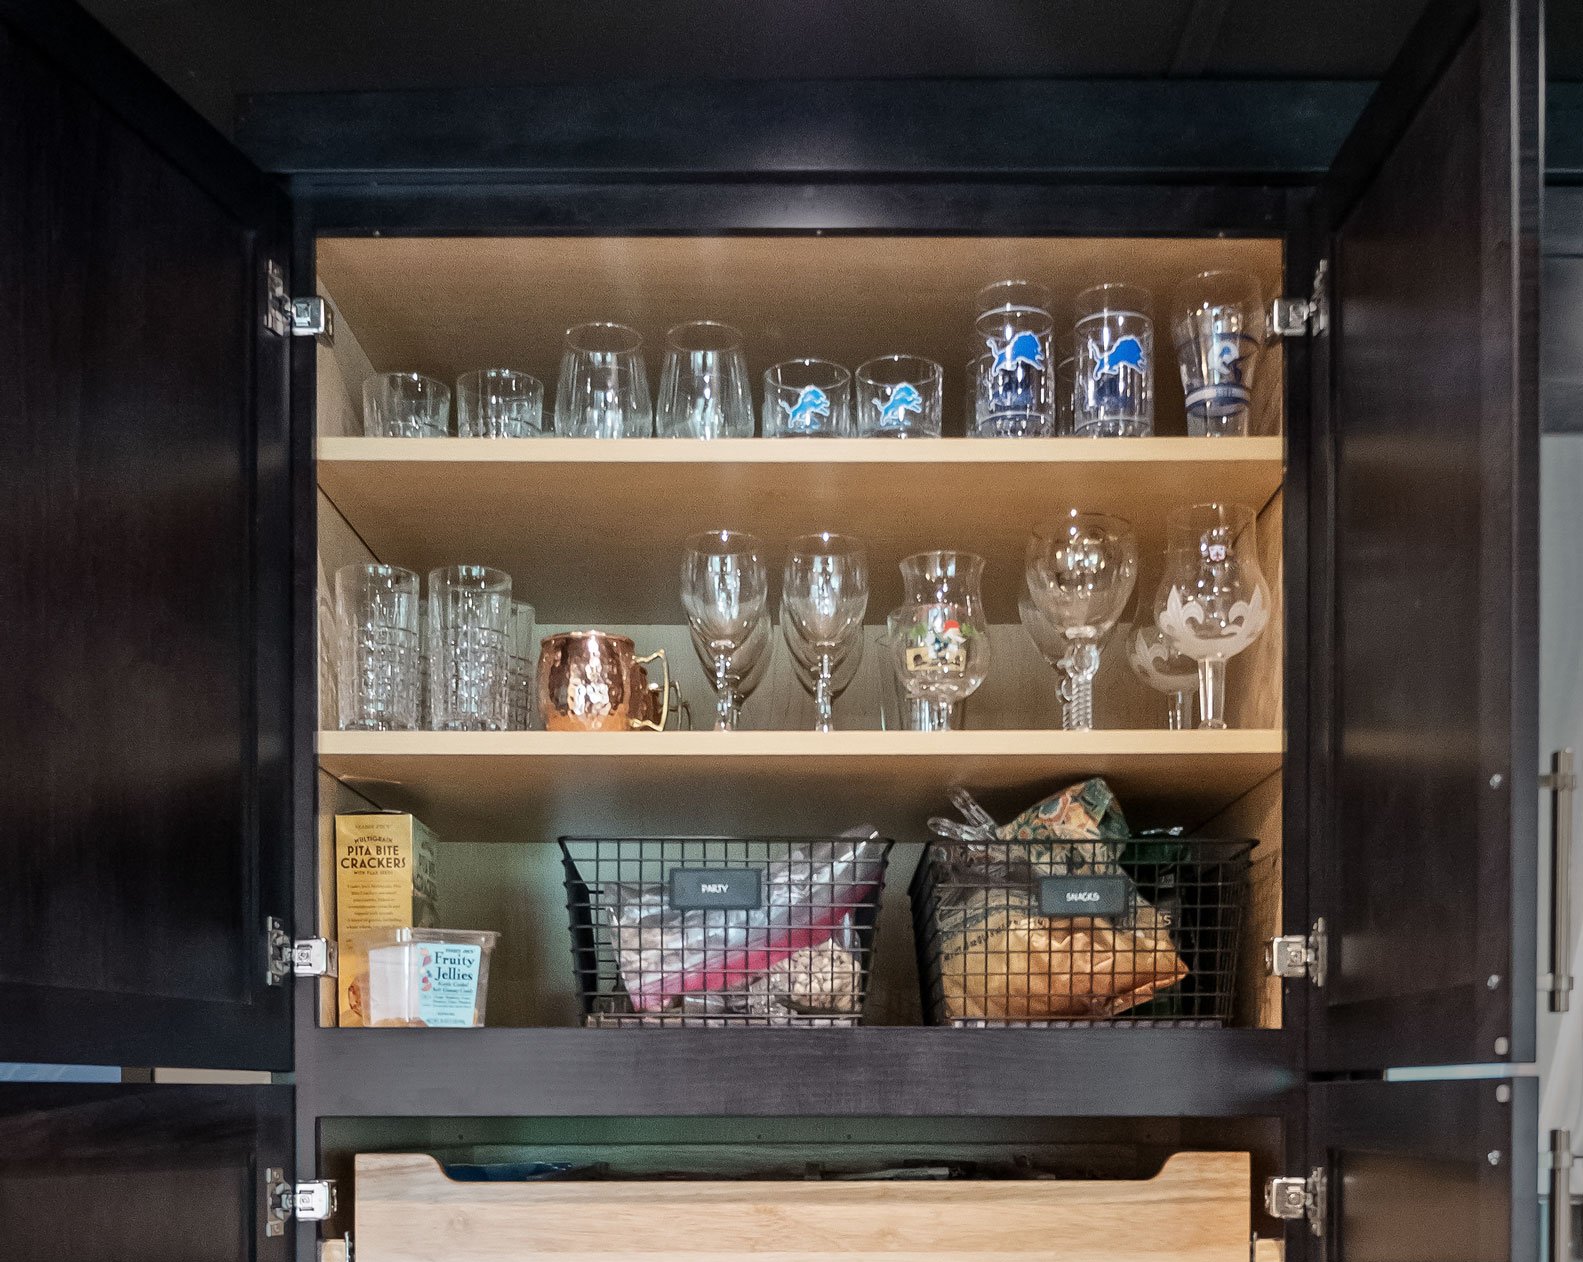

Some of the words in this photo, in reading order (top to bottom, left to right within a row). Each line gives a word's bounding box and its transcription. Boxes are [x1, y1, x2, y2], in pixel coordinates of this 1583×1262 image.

[347, 846, 371, 856] PITA
[376, 846, 399, 855] BITE
[341, 857, 406, 868] CRACKERS
[701, 884, 729, 893] PARTY
[1066, 892, 1100, 901] SNACKS
[434, 951, 475, 968] Fruity
[434, 967, 473, 981] Jellies
